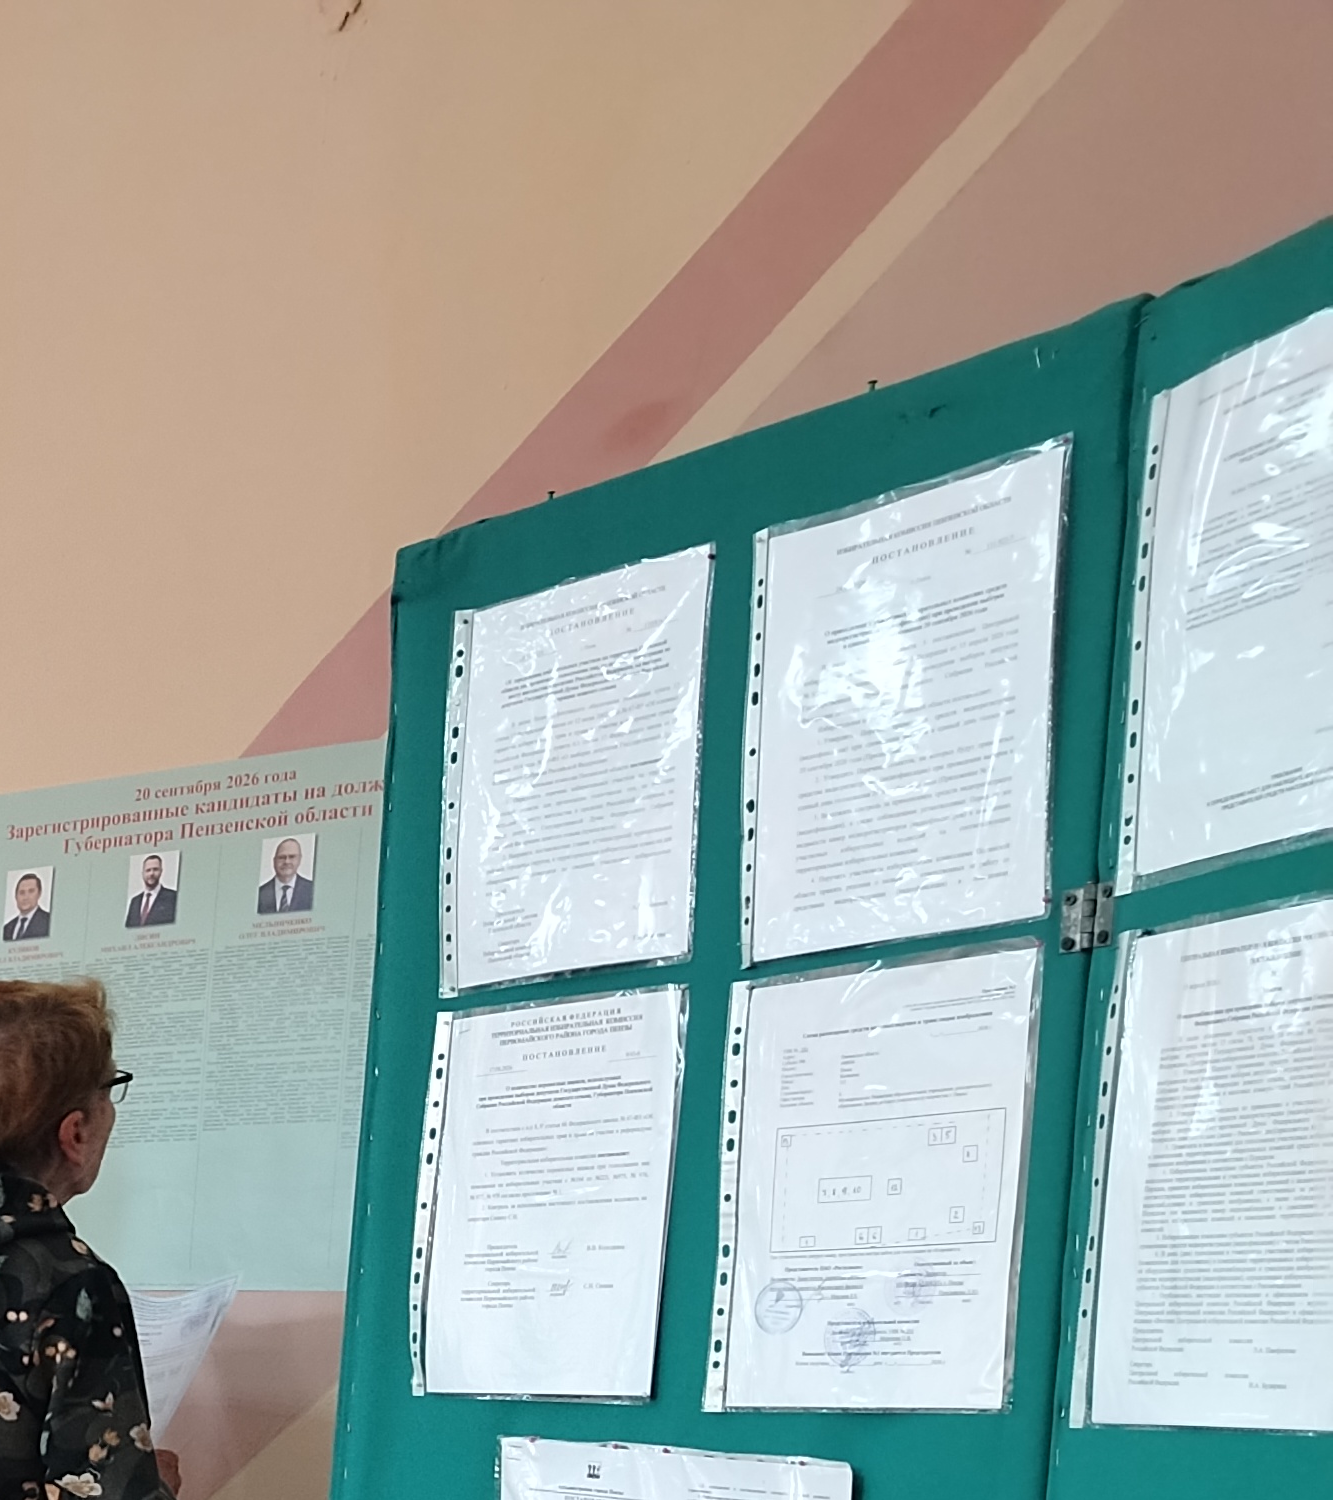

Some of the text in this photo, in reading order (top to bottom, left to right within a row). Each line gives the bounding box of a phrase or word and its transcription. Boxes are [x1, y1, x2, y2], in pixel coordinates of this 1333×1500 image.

[872, 527, 975, 564] ПОСТАНОВЛЕНИЕ
[135, 770, 297, 802] 20 сентября 2026 года
[6, 803, 189, 841] Зарегистрированные
[194, 789, 297, 815] кандидаты
[304, 784, 326, 801] на
[63, 804, 373, 857] Губернатора Пензенской области
[511, 1008, 621, 1028] РОССИЙСКАЯ ФЕДЕРАЦИЯ
[522, 1045, 607, 1061] ПОСТАНОВЛЕНИЕ
